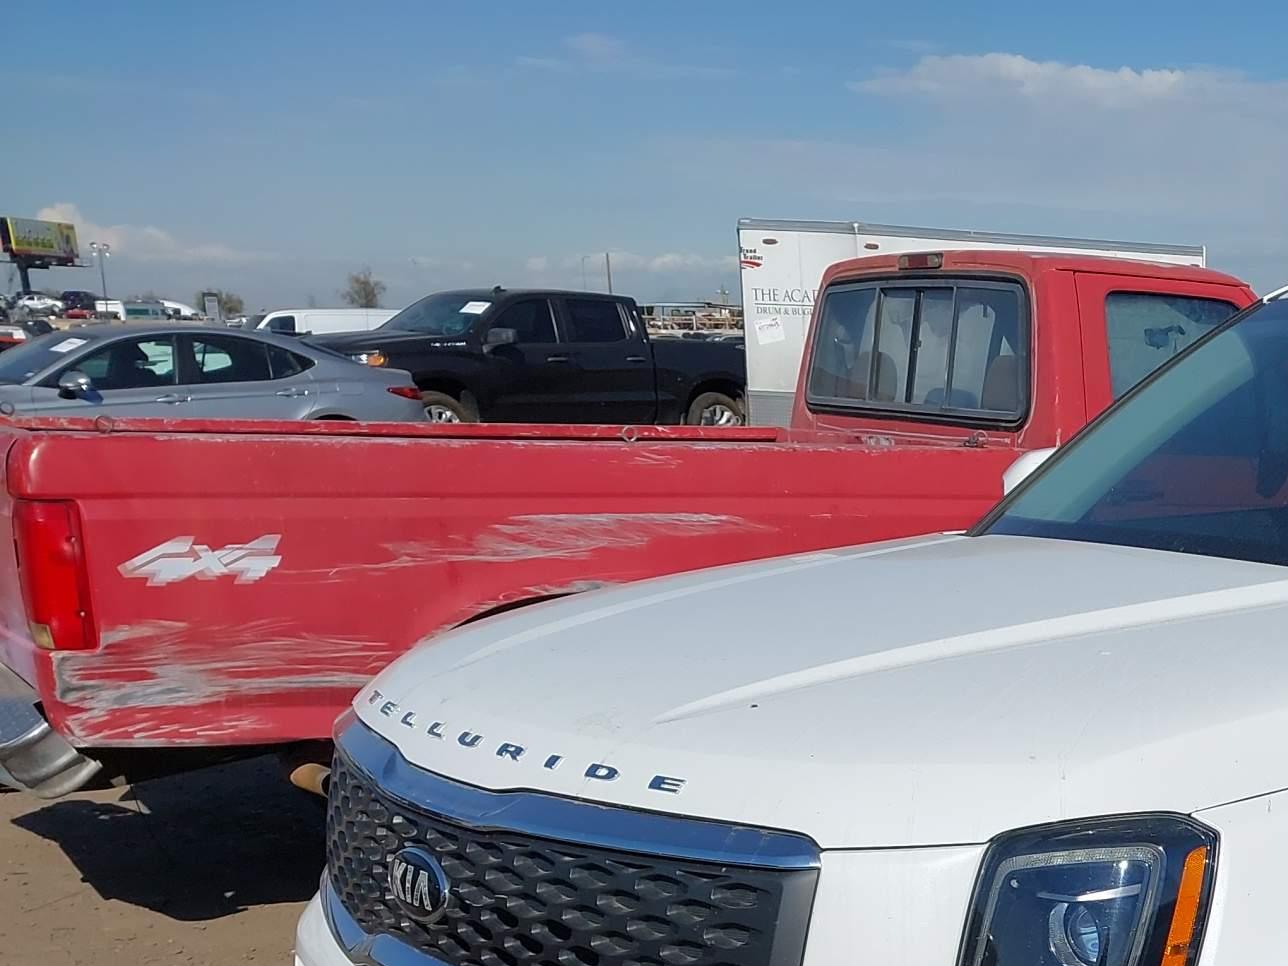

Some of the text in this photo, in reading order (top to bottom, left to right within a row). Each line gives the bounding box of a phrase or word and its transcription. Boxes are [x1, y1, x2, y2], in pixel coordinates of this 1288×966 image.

[751, 287, 779, 302] THE
[756, 306, 781, 315] DRUM
[783, 307, 790, 316] &
[367, 689, 688, 796] TELLURIDE
[392, 859, 433, 912] KIA
